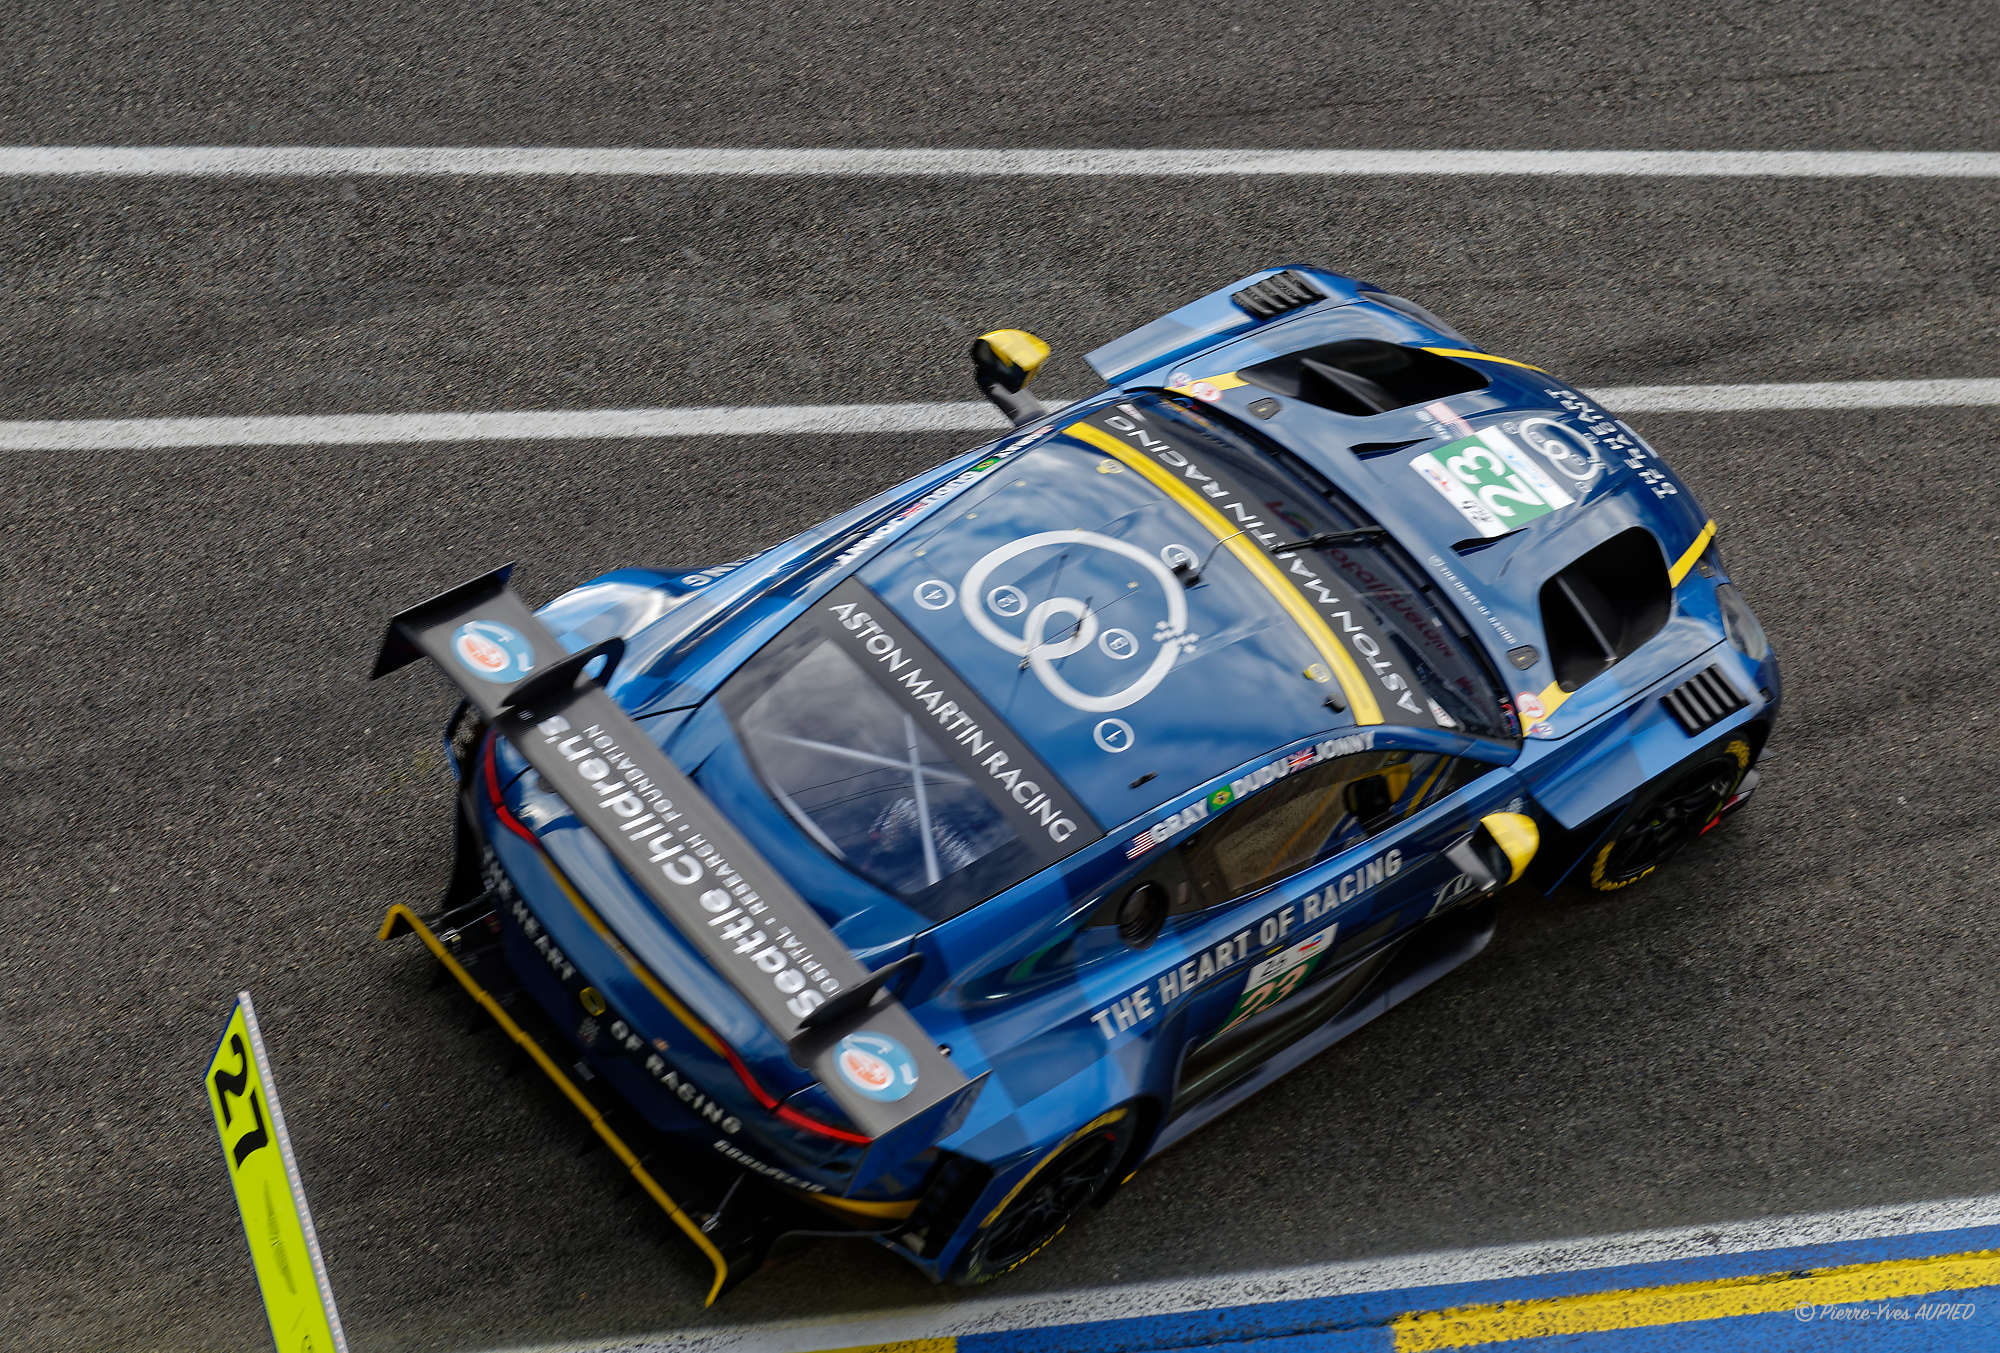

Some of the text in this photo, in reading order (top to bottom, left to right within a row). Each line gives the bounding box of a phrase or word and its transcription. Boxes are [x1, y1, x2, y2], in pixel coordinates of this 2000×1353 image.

[1103, 415, 1230, 498] RACING
[1447, 445, 1546, 517] 23
[1544, 388, 1667, 500] THE HEART
[1331, 609, 1424, 714] ASTON
[582, 723, 683, 824] FOUNDATION
[829, 601, 1078, 844] ASTON MARTIN RACING
[1149, 730, 1376, 845] GRAY DUDU JONNY
[536, 714, 827, 1019] Seattle Children's
[684, 833, 769, 916] RESEARCH
[1090, 985, 1155, 1041] THE
[1157, 929, 1251, 1006] HEART
[1259, 905, 1296, 946] OF
[1303, 848, 1403, 925] RACING
[511, 899, 577, 981] HEART
[610, 1018, 645, 1052] OF
[645, 1052, 743, 1135] RACING
[1217, 963, 1310, 1037] 23
